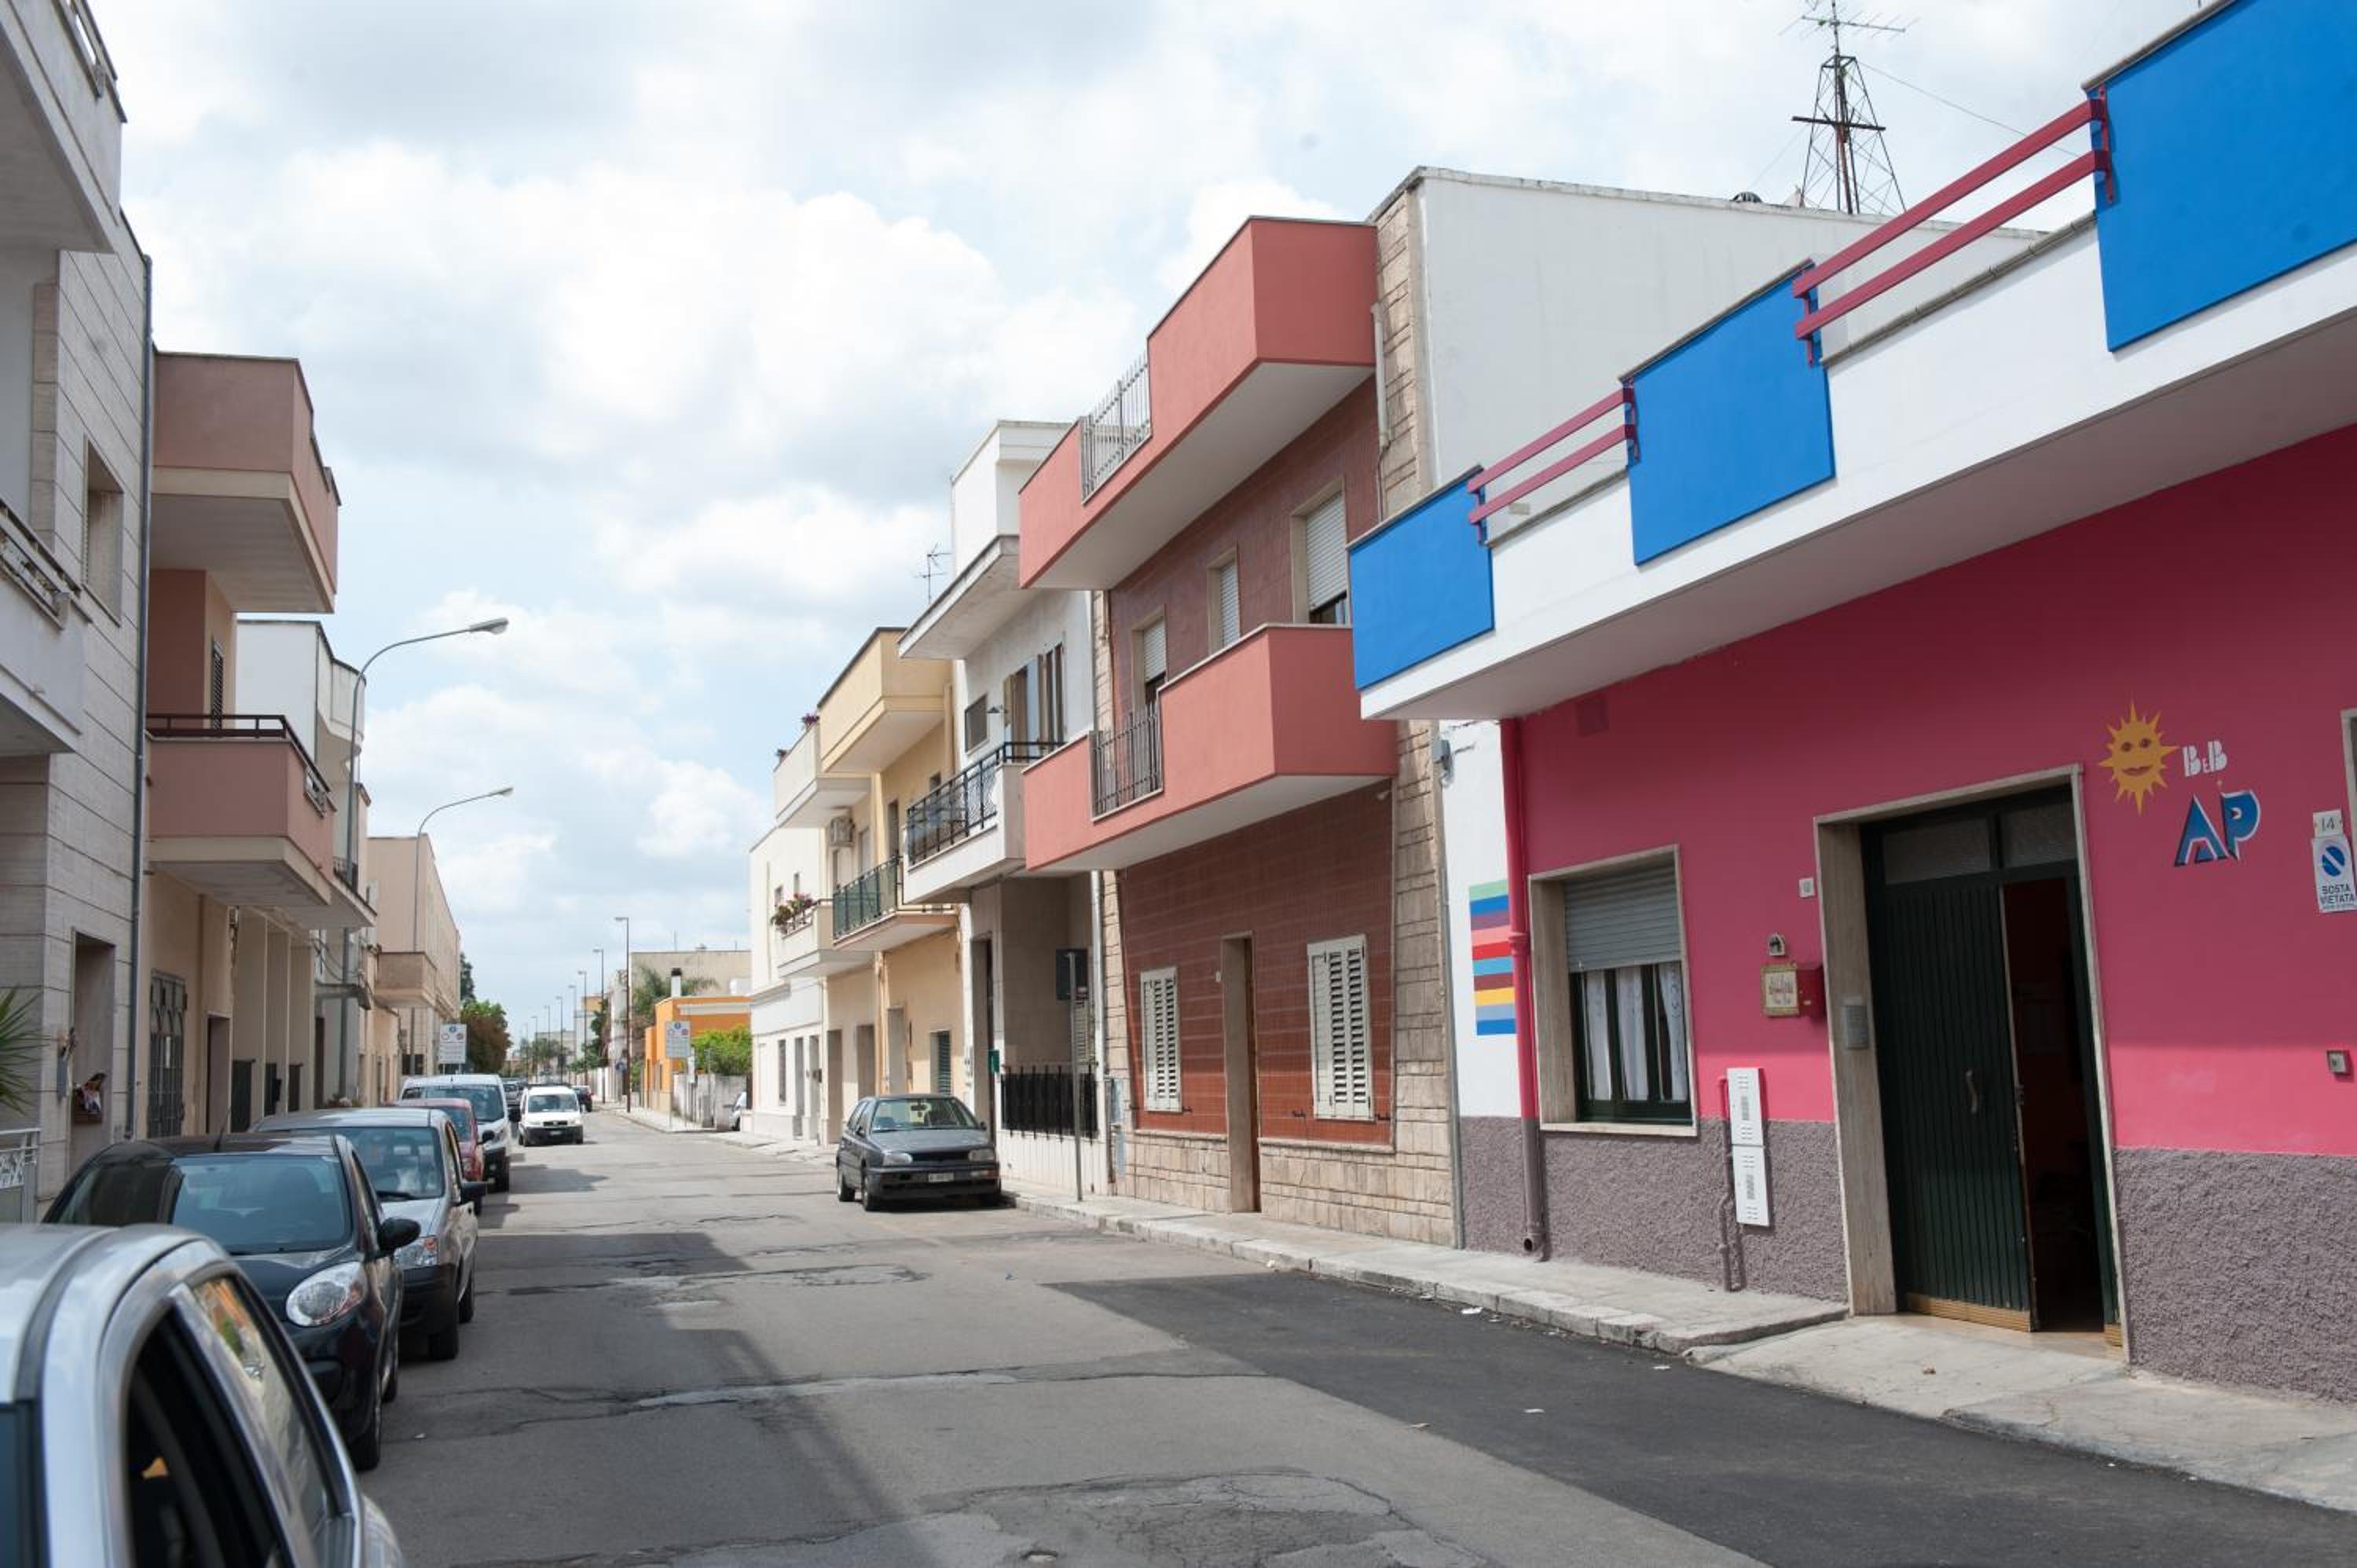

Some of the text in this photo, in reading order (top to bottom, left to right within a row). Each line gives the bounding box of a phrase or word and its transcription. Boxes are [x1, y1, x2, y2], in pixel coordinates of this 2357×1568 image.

[2174, 789, 2261, 867] AP
[2322, 883, 2351, 894] SOSTA
[2320, 893, 2355, 904] VIETATA
